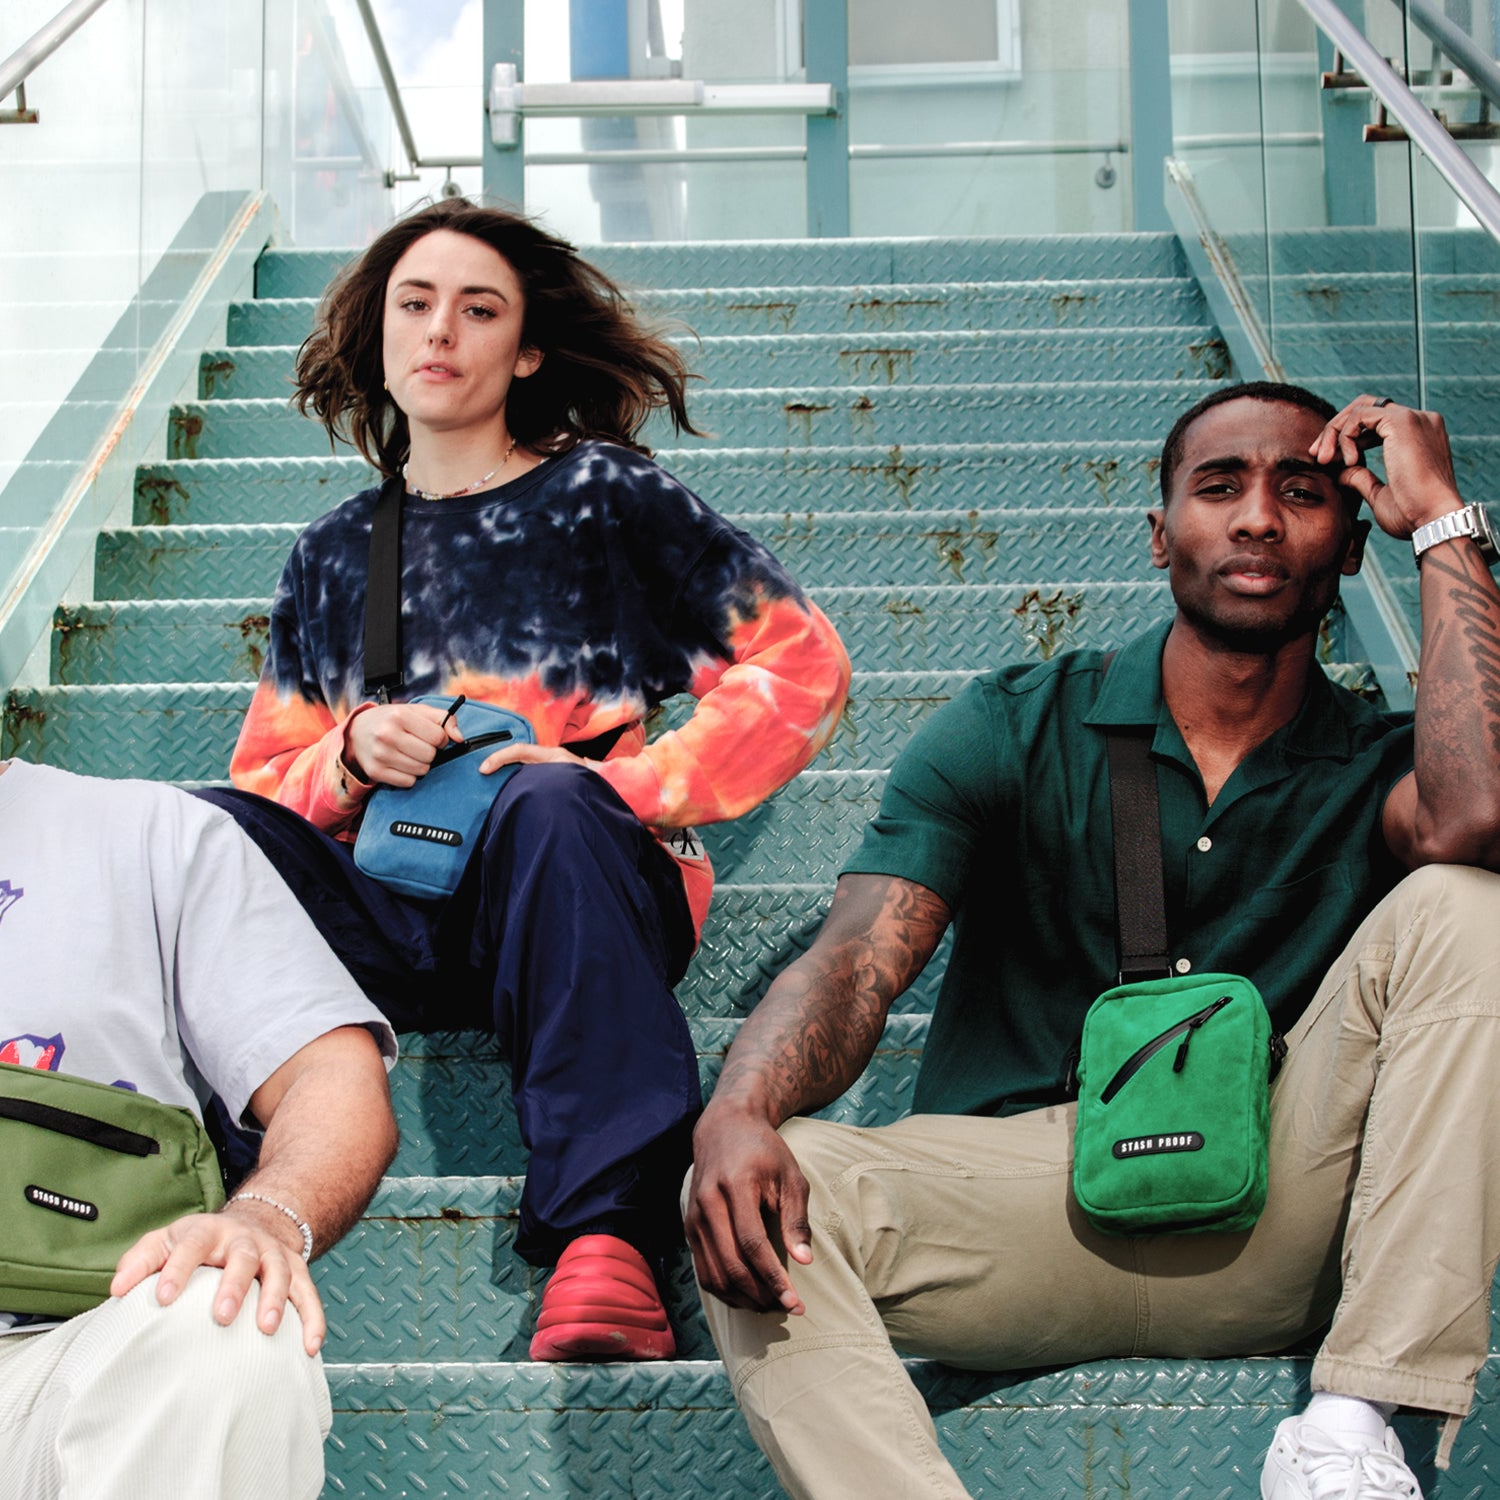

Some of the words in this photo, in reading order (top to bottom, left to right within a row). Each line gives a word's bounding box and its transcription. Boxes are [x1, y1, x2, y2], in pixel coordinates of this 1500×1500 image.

[396, 823, 424, 836] STASH
[426, 828, 454, 842] PROOF
[1121, 1139, 1153, 1153] STASH
[1158, 1135, 1193, 1148] PROOF
[32, 1189, 60, 1206] STASH
